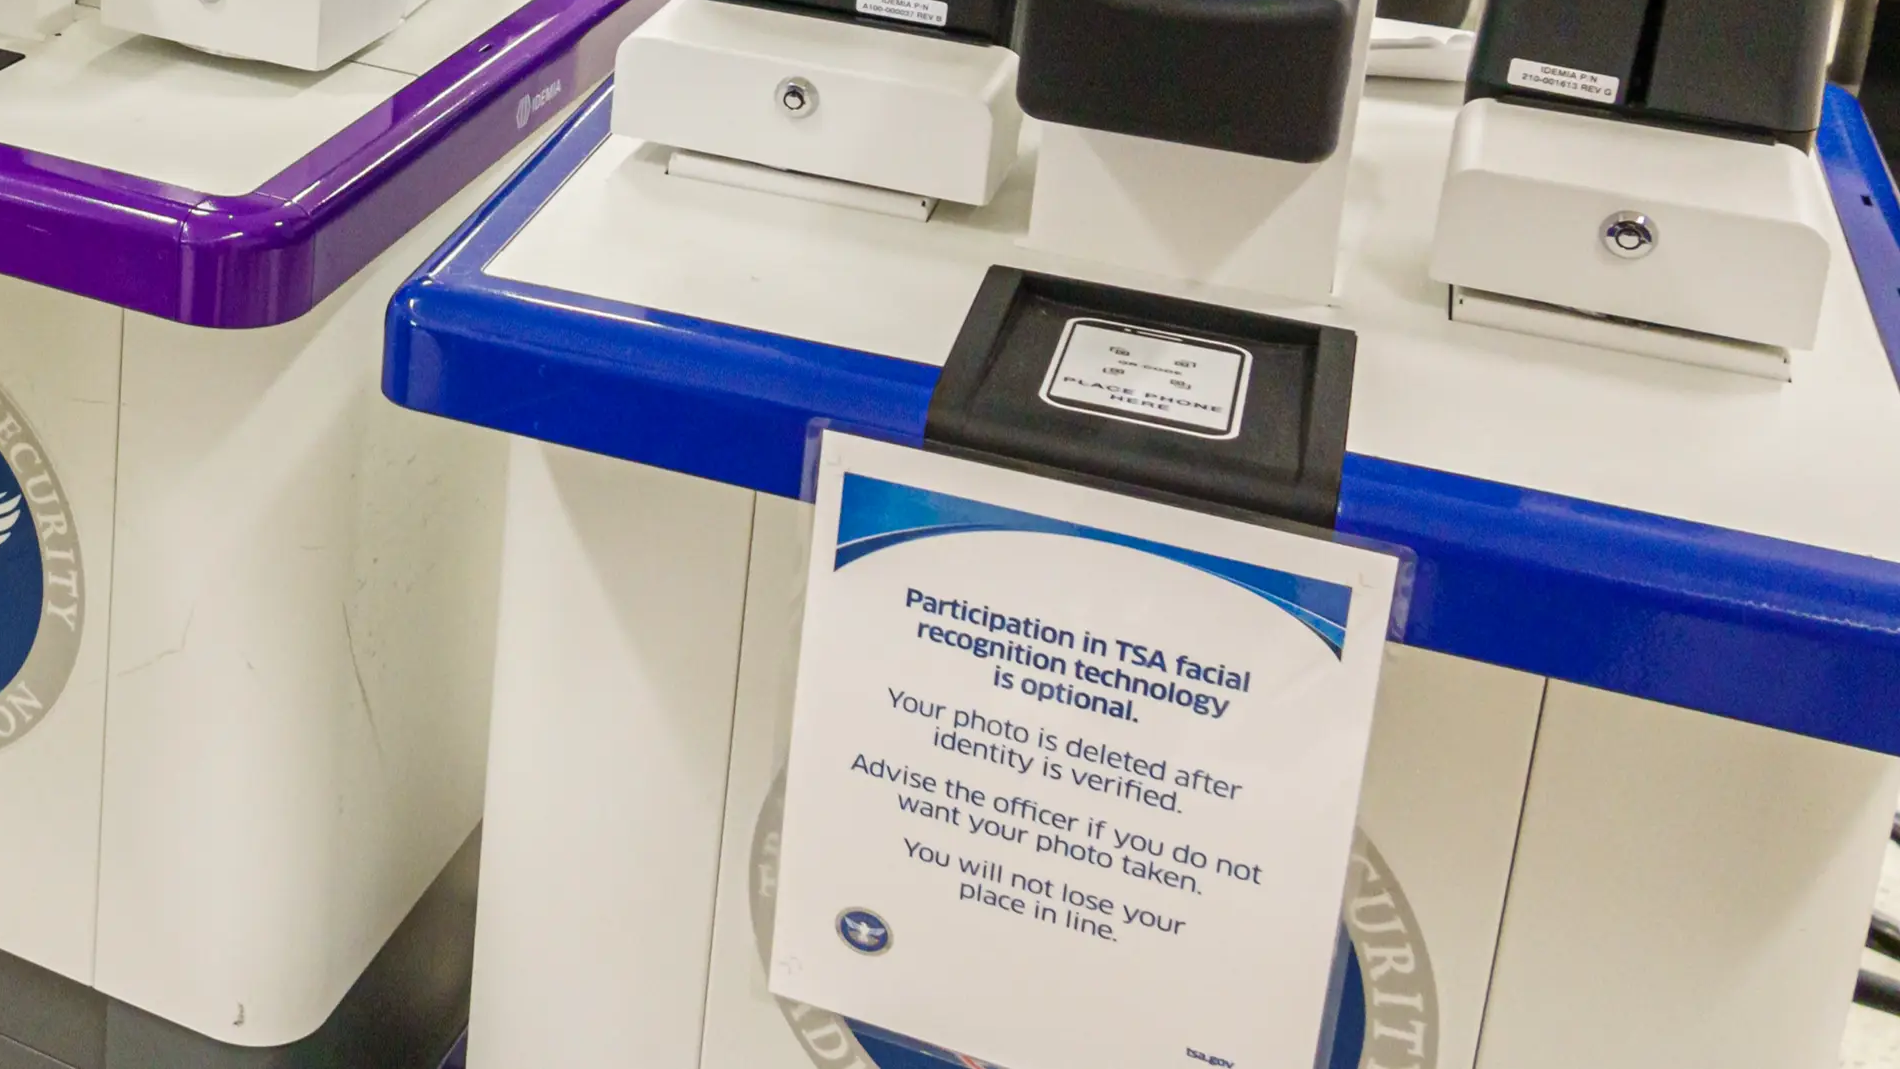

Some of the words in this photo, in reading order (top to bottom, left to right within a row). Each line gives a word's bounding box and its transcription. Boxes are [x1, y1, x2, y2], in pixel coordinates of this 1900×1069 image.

[917, 11, 934, 21] REV
[532, 79, 561, 112] IDEMIA
[1541, 66, 1577, 79] IDEMIA
[1581, 83, 1602, 95] REV
[1063, 375, 1135, 396] PLACE
[1145, 391, 1223, 414] PHONE
[1110, 393, 1171, 412] HERE
[906, 587, 1074, 649] Participation
[1082, 631, 1107, 657] in
[1115, 639, 1168, 673] TSA
[1176, 655, 1250, 692] facial
[917, 622, 1067, 676] recognition
[1074, 659, 1230, 719] technology
[994, 665, 1014, 690] is
[1021, 678, 1138, 723] optional.
[888, 687, 947, 720] Your
[954, 709, 1029, 744] photo
[1038, 728, 1057, 751] is
[1066, 738, 1166, 781] deleted
[1174, 769, 1243, 800] after
[934, 726, 1034, 774] identity
[1043, 756, 1062, 780] is
[1072, 768, 1182, 814] verified.
[851, 754, 936, 793] Advise
[945, 779, 985, 807] the
[993, 797, 1079, 832] officer
[1088, 817, 1107, 839] if
[1114, 829, 1164, 856] you
[1172, 844, 1207, 868] do
[1216, 858, 1262, 885] not
[898, 794, 961, 826] want
[969, 814, 1029, 844] your
[1036, 834, 1113, 868] photo
[1122, 855, 1201, 895] taken.
[904, 838, 950, 867] You
[959, 857, 1002, 883] will
[1011, 873, 1054, 898] not
[1062, 883, 1114, 915] lose
[1123, 905, 1186, 935] your
[960, 882, 1025, 915] place
[1034, 900, 1056, 924] in
[1066, 910, 1117, 942] line.
[1186, 1047, 1234, 1069] tsa.gov
